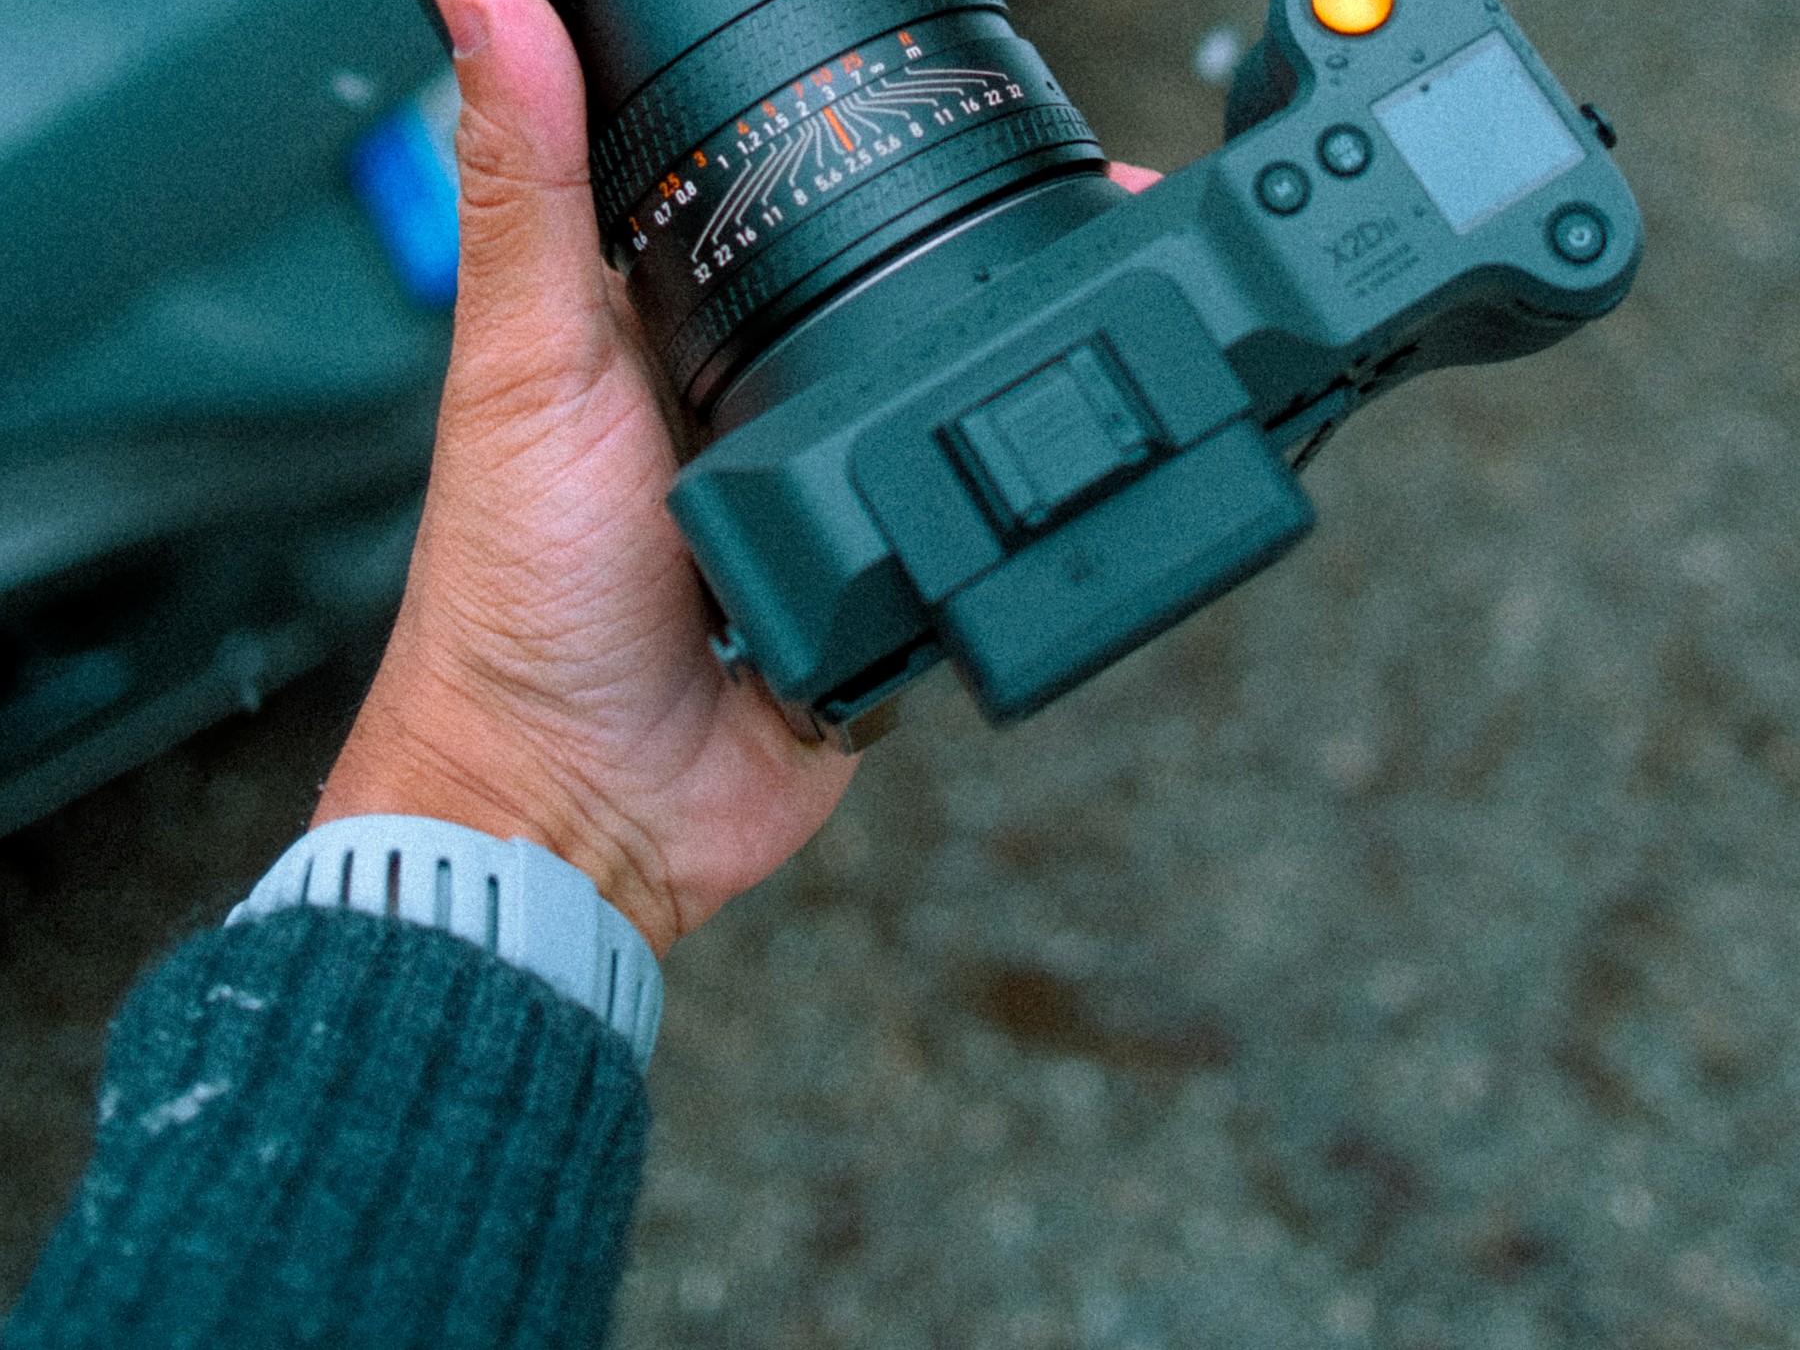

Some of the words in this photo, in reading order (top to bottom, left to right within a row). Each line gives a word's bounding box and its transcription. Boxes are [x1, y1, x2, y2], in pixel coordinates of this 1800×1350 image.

[632, 231, 648, 251] 0.6
[654, 201, 672, 225] 0.7
[675, 180, 697, 205] 0.8
[717, 155, 729, 169] 1
[737, 131, 763, 154] 1.2
[763, 113, 789, 136] 1.5
[795, 101, 810, 117] 2
[822, 85, 836, 100] 3
[850, 70, 861, 86] 7
[906, 46, 922, 60] m
[693, 150, 708, 168] 3
[693, 263, 712, 284] 32
[713, 244, 734, 267] 22
[736, 226, 757, 247] 16
[762, 206, 784, 227] 11
[792, 188, 808, 206] 8
[815, 168, 842, 192] 5.6
[845, 150, 872, 173] 2.5
[874, 135, 902, 156] 5.6
[909, 122, 924, 138] 8
[934, 109, 954, 126] 11
[960, 97, 980, 115] 16
[984, 89, 1003, 106] 22
[1005, 84, 1024, 98] 32
